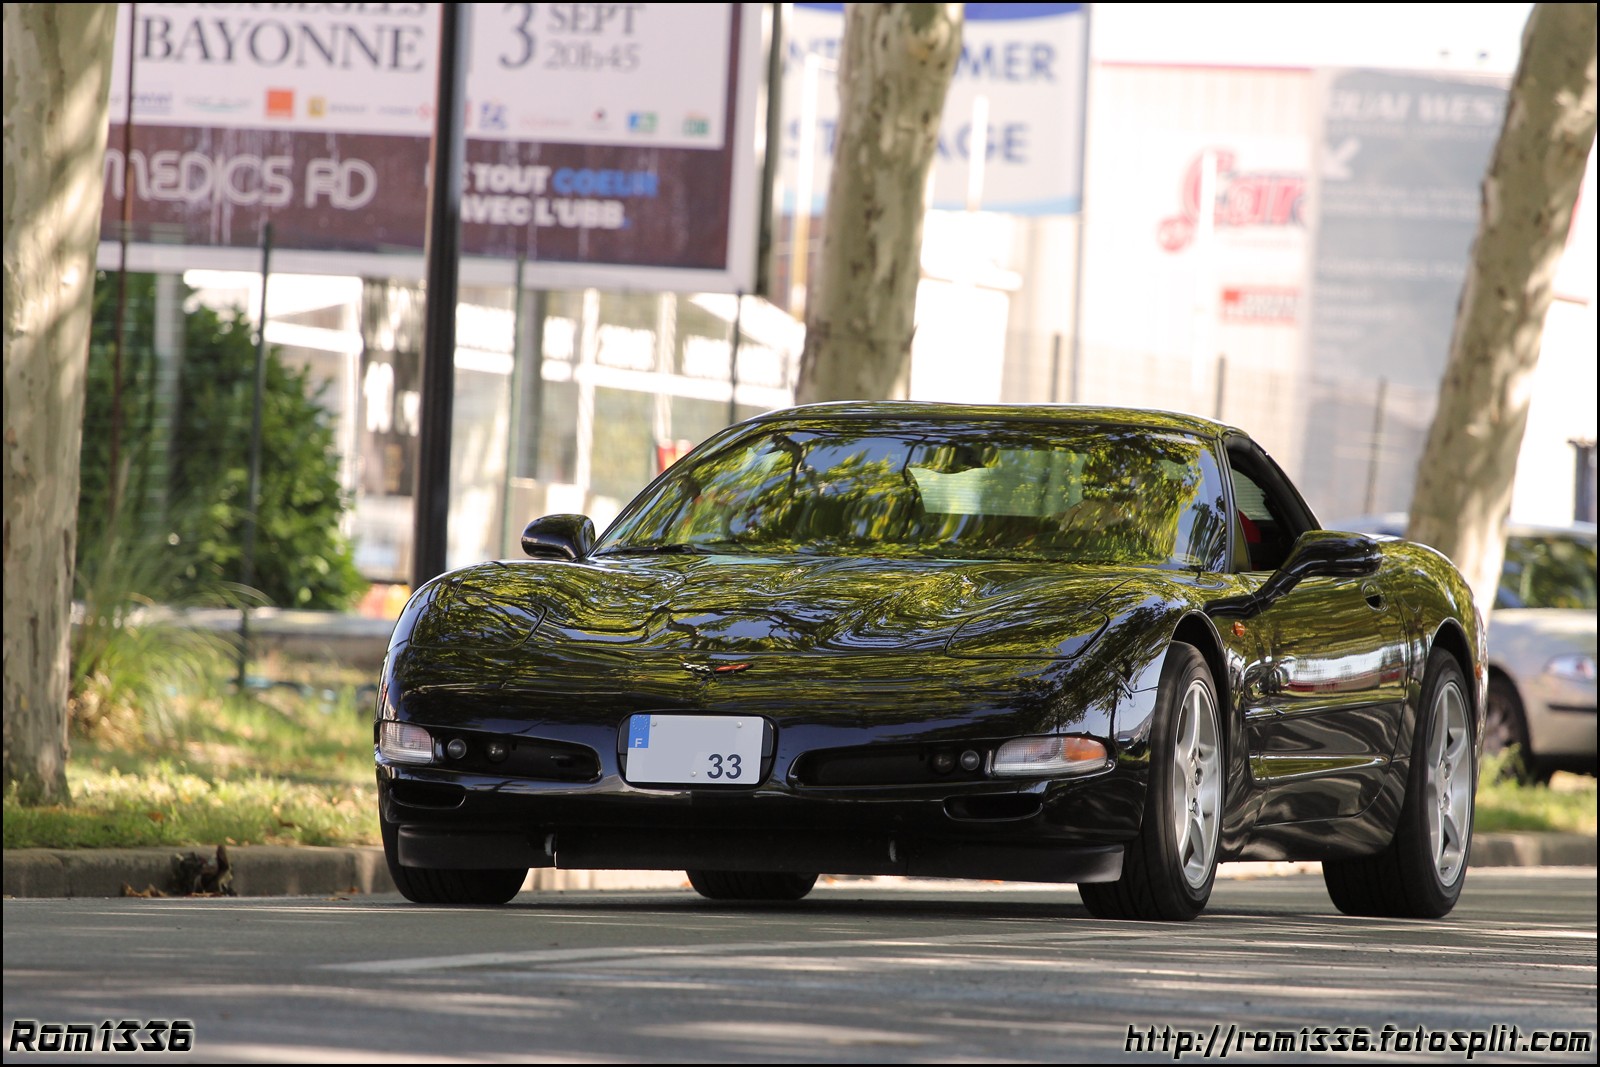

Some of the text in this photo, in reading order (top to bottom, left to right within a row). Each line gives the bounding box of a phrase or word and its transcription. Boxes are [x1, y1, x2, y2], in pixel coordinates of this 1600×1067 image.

[138, 13, 426, 73] BAYONNE
[472, 163, 551, 194] TOUT
[460, 194, 532, 226] AVEC
[634, 737, 643, 748] F
[707, 753, 742, 779] 33
